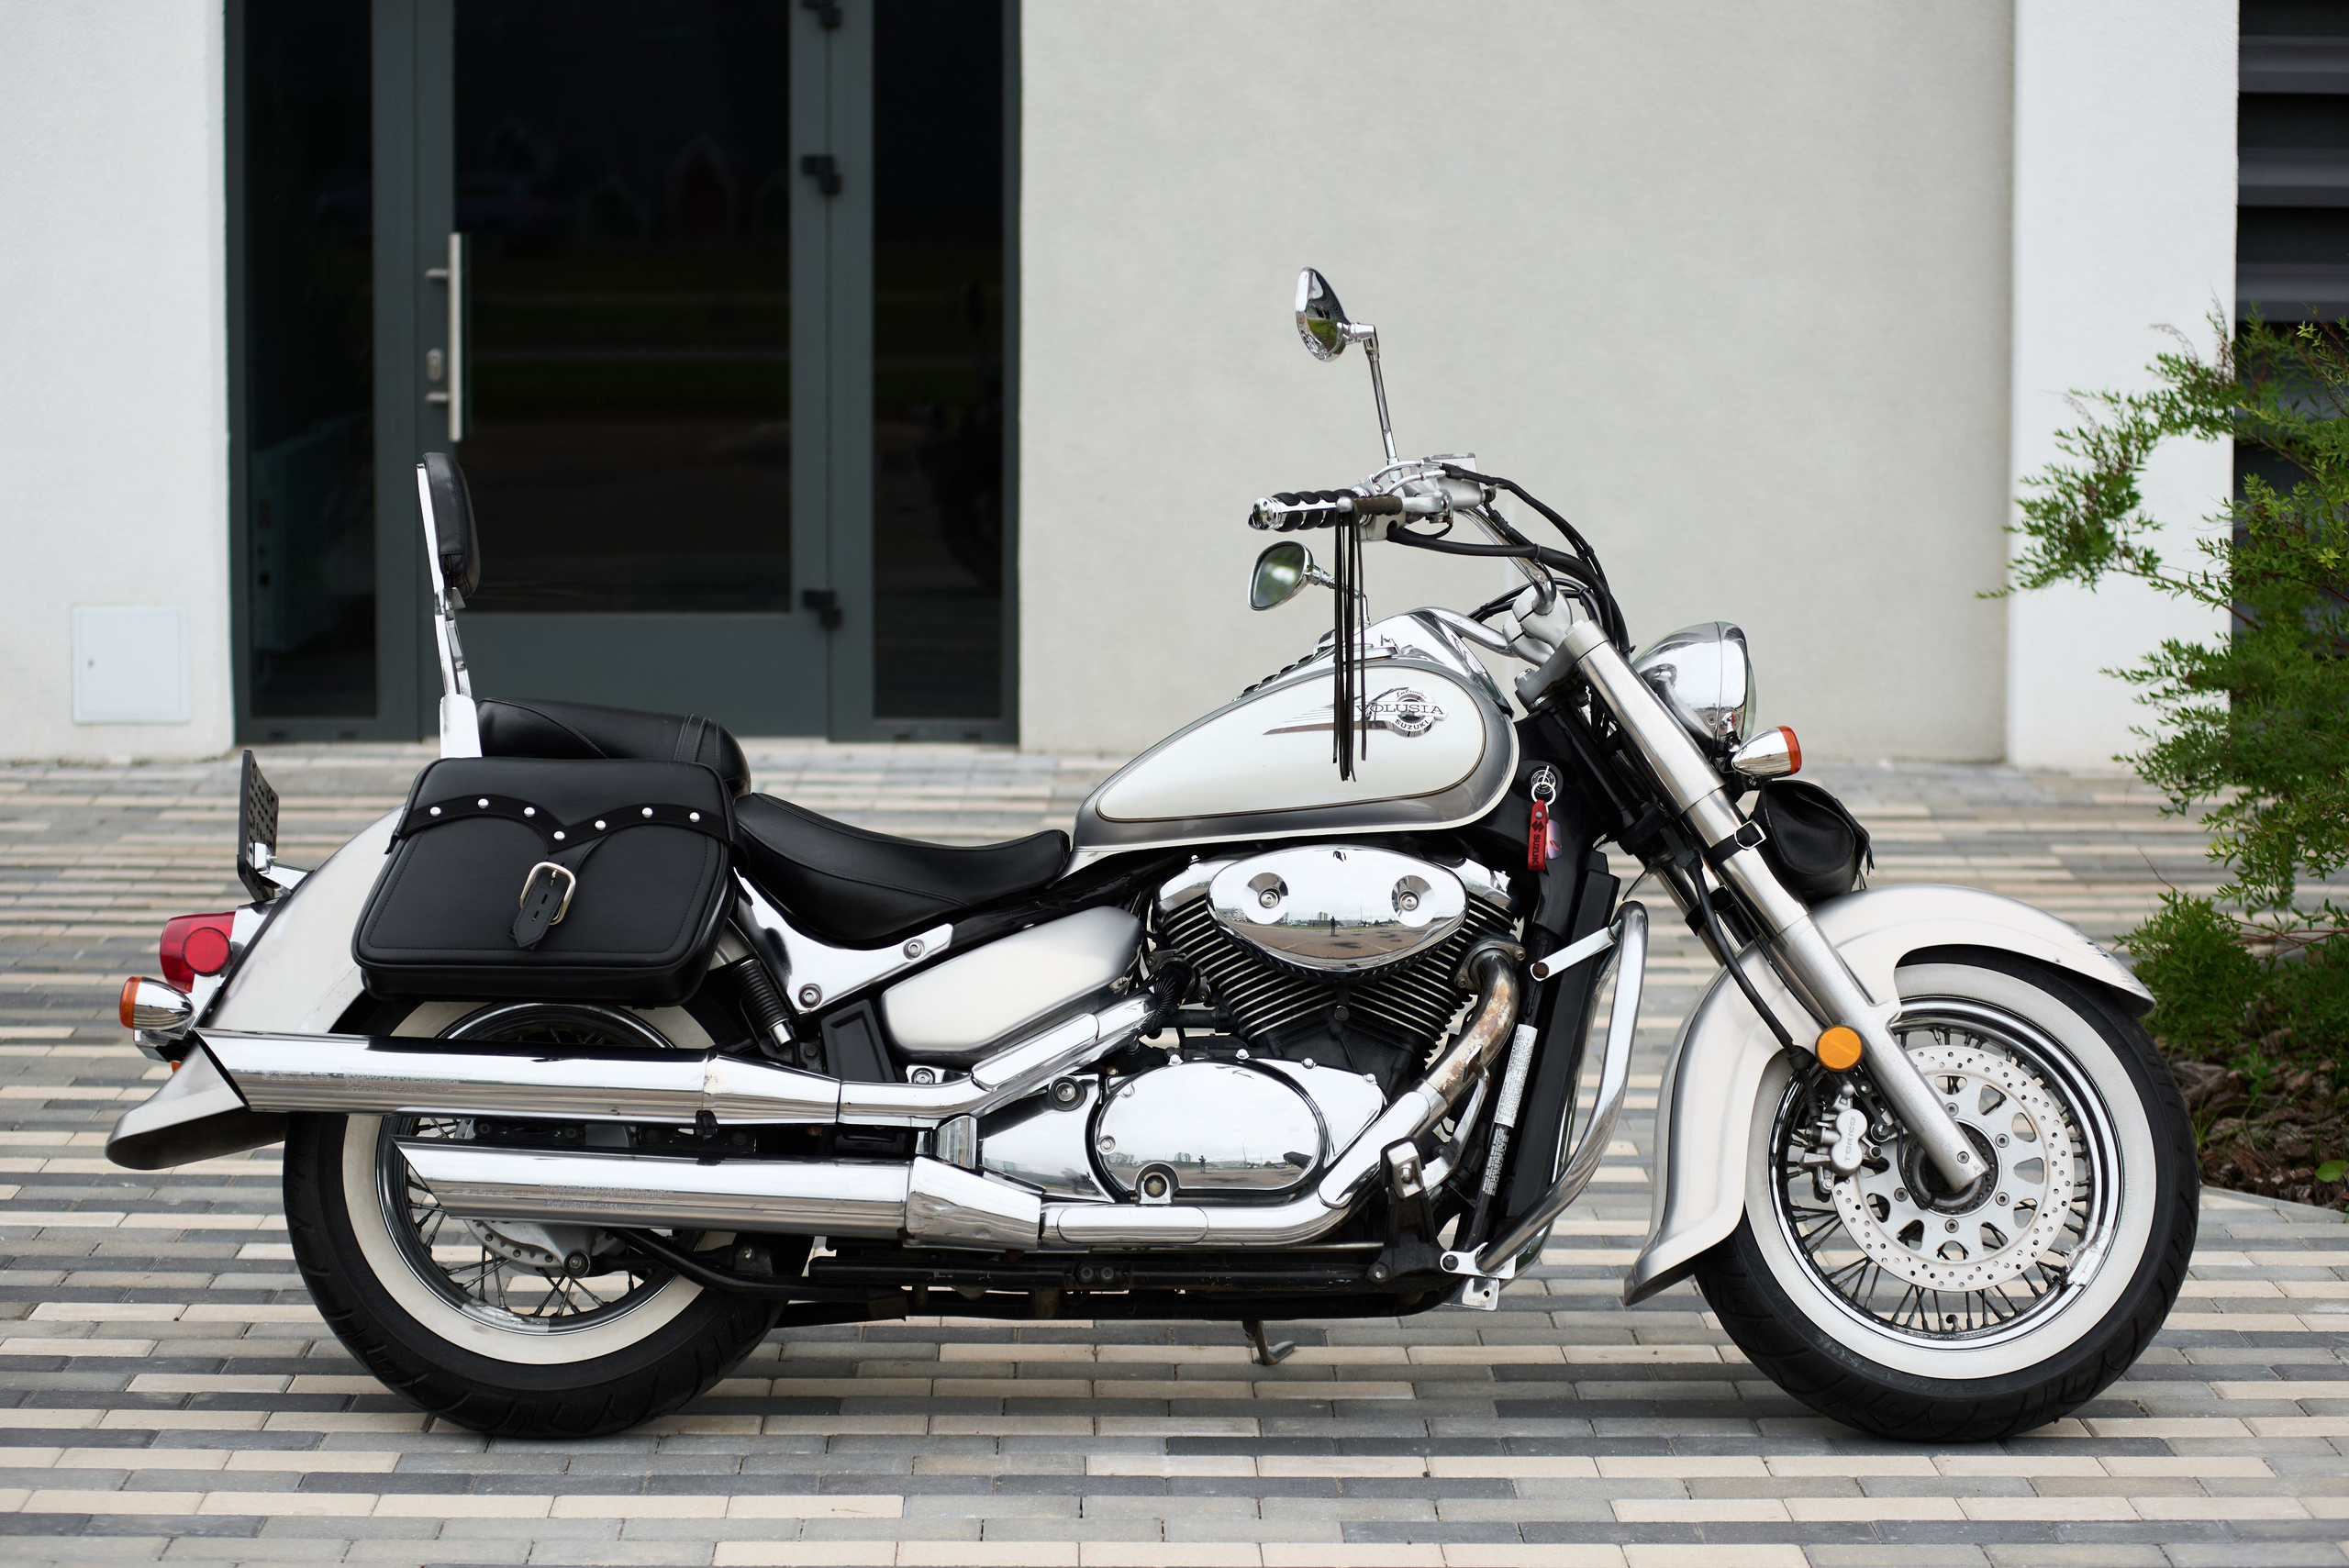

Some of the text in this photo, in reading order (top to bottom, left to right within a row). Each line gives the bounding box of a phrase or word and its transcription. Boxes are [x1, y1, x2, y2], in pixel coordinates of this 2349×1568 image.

[1395, 718, 1429, 730] SUZUKI
[1531, 833, 1541, 869] SUZUKI
[1844, 1117, 1856, 1162] TOKICO
